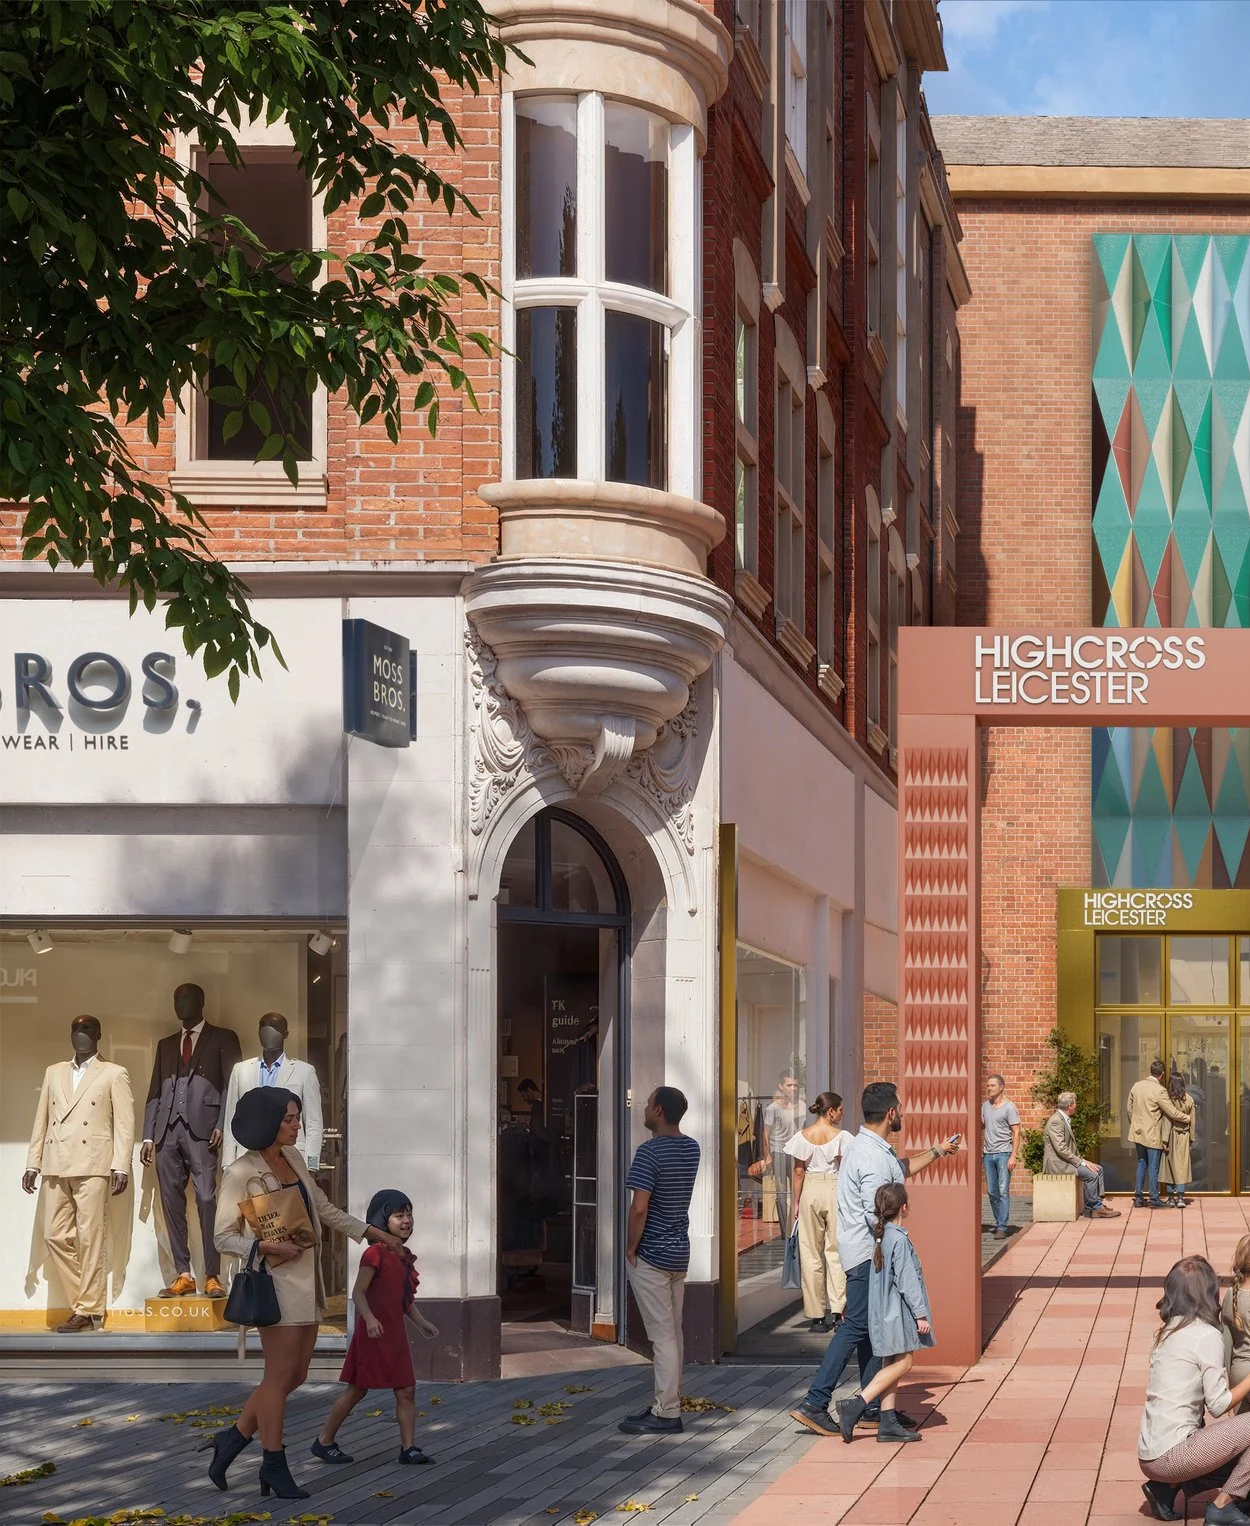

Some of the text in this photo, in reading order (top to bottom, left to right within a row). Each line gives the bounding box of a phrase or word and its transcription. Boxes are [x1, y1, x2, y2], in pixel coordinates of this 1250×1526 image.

[975, 635, 1206, 669] HIGHCROSS
[373, 654, 403, 685] MOSS
[373, 681, 406, 712] BROS.
[975, 671, 1149, 704] LEICESTER
[2, 735, 129, 750] WEAR HIRE
[1084, 893, 1193, 909] HIGHCROSS
[1084, 909, 1167, 925] LEICESTER
[552, 1014, 580, 1028] guide
